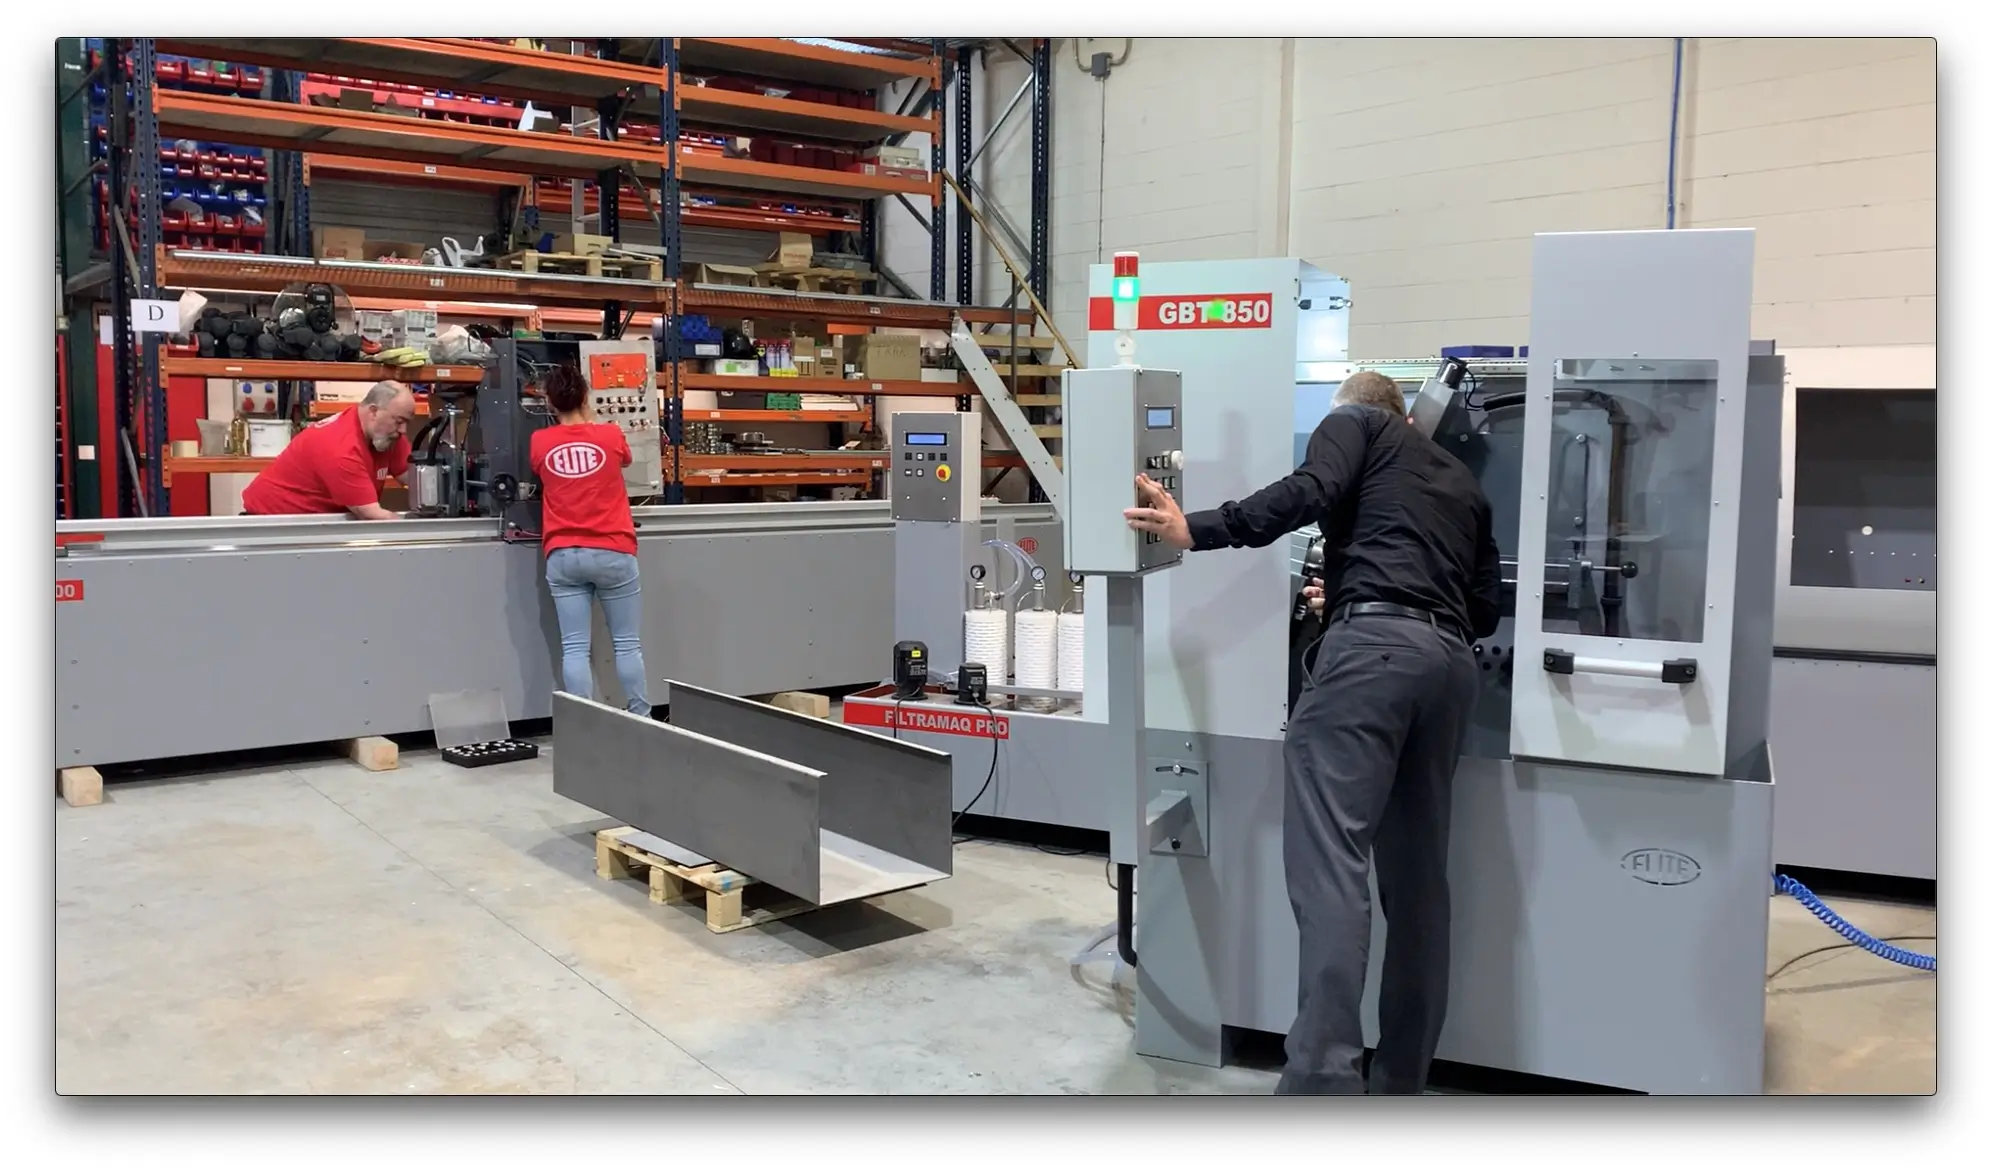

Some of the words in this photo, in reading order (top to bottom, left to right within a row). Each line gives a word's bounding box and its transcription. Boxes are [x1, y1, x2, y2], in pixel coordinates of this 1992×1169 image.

[148, 305, 164, 321] D
[1159, 301, 1212, 324] GBT
[1222, 300, 1269, 323] 850
[553, 446, 598, 473] ELITE
[884, 710, 971, 733] FILTRAMAQ
[976, 719, 1007, 735] PRO
